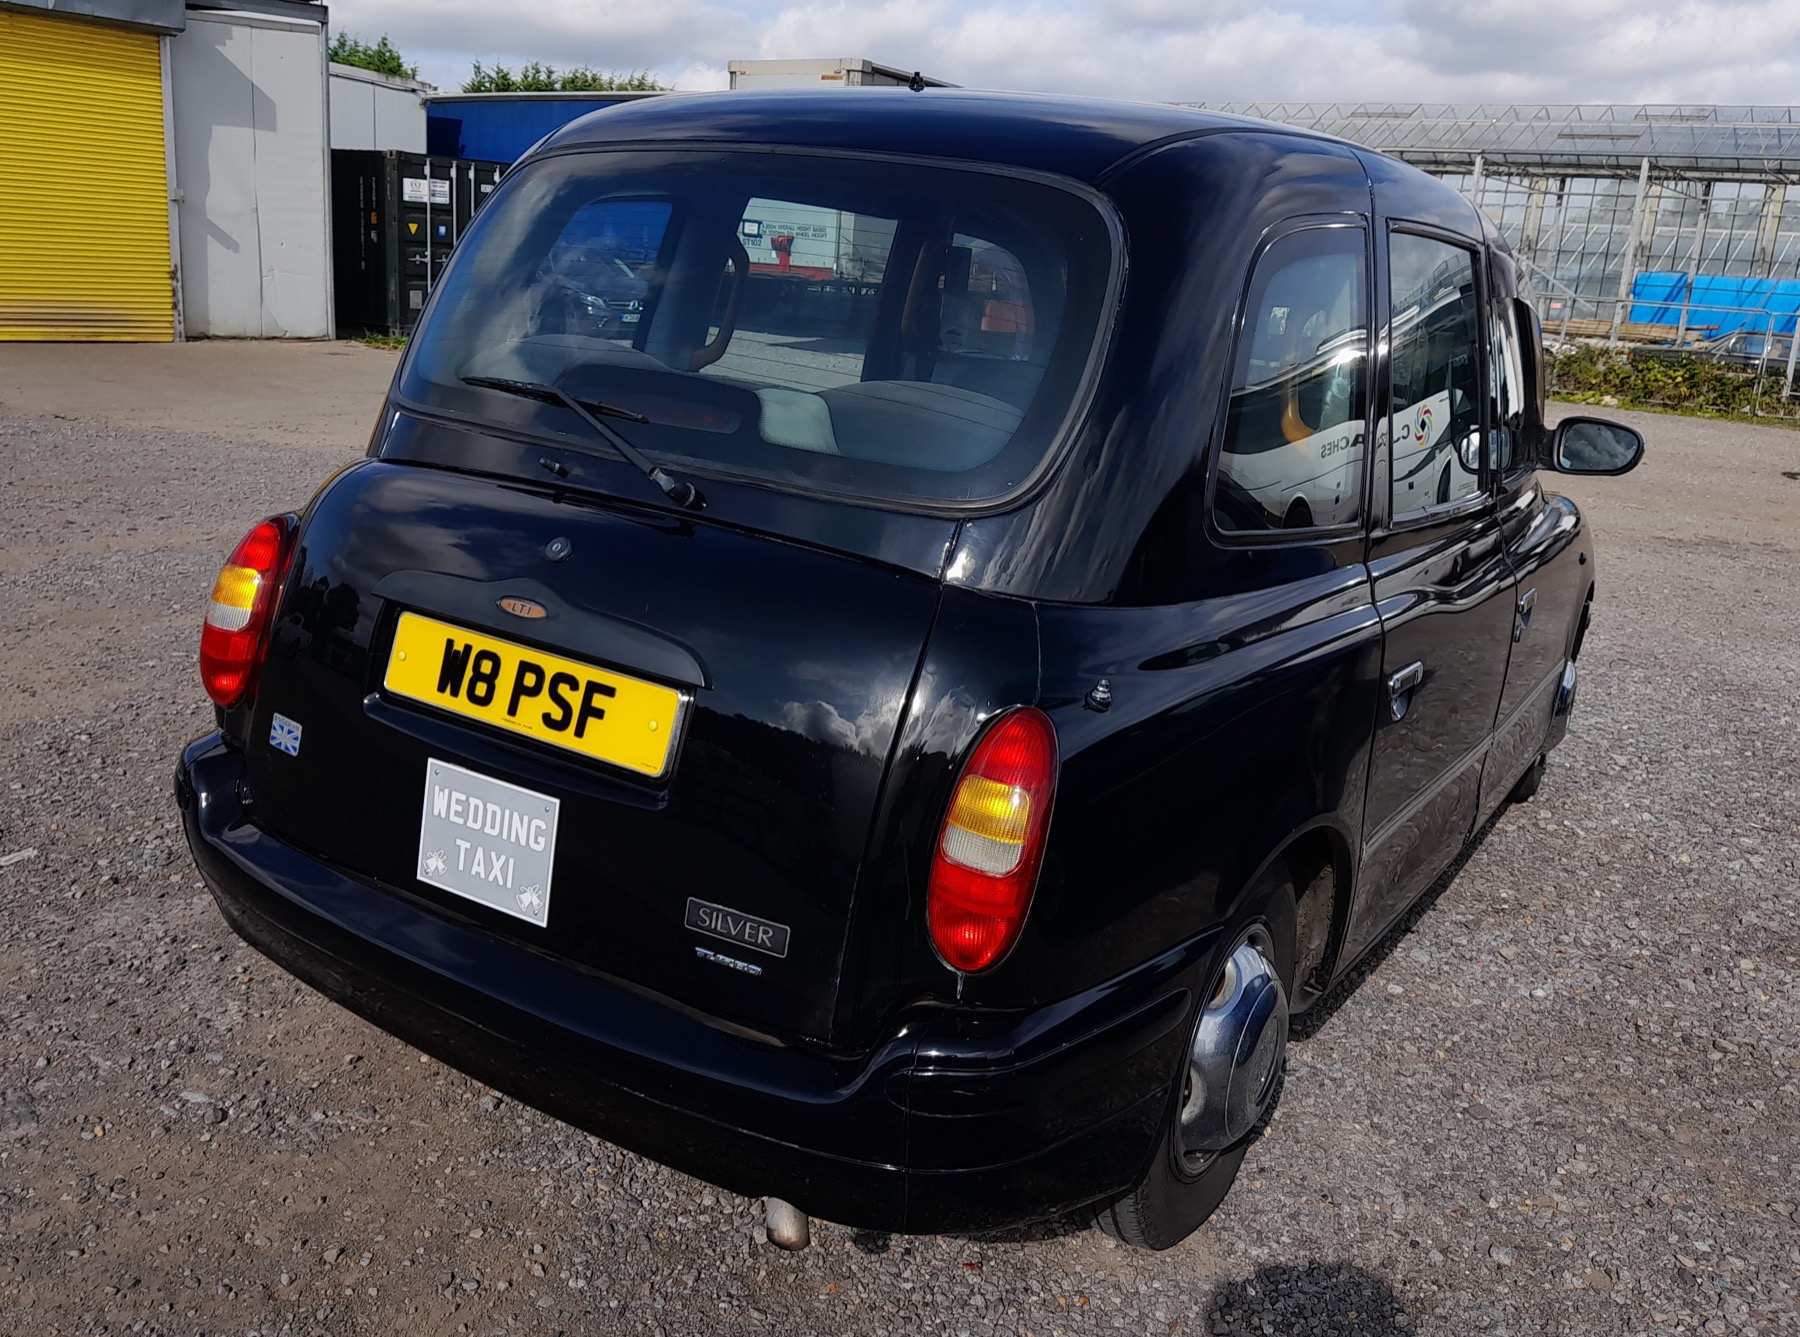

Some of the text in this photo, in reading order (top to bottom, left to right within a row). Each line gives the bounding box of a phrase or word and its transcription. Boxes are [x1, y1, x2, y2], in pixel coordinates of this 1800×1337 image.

[742, 238, 762, 246] ST102
[512, 602, 532, 615] LTI
[437, 638, 617, 739] W8 PSF
[433, 785, 547, 852] WEDDING
[455, 838, 514, 889] TAXI
[697, 907, 774, 948] SILVER
